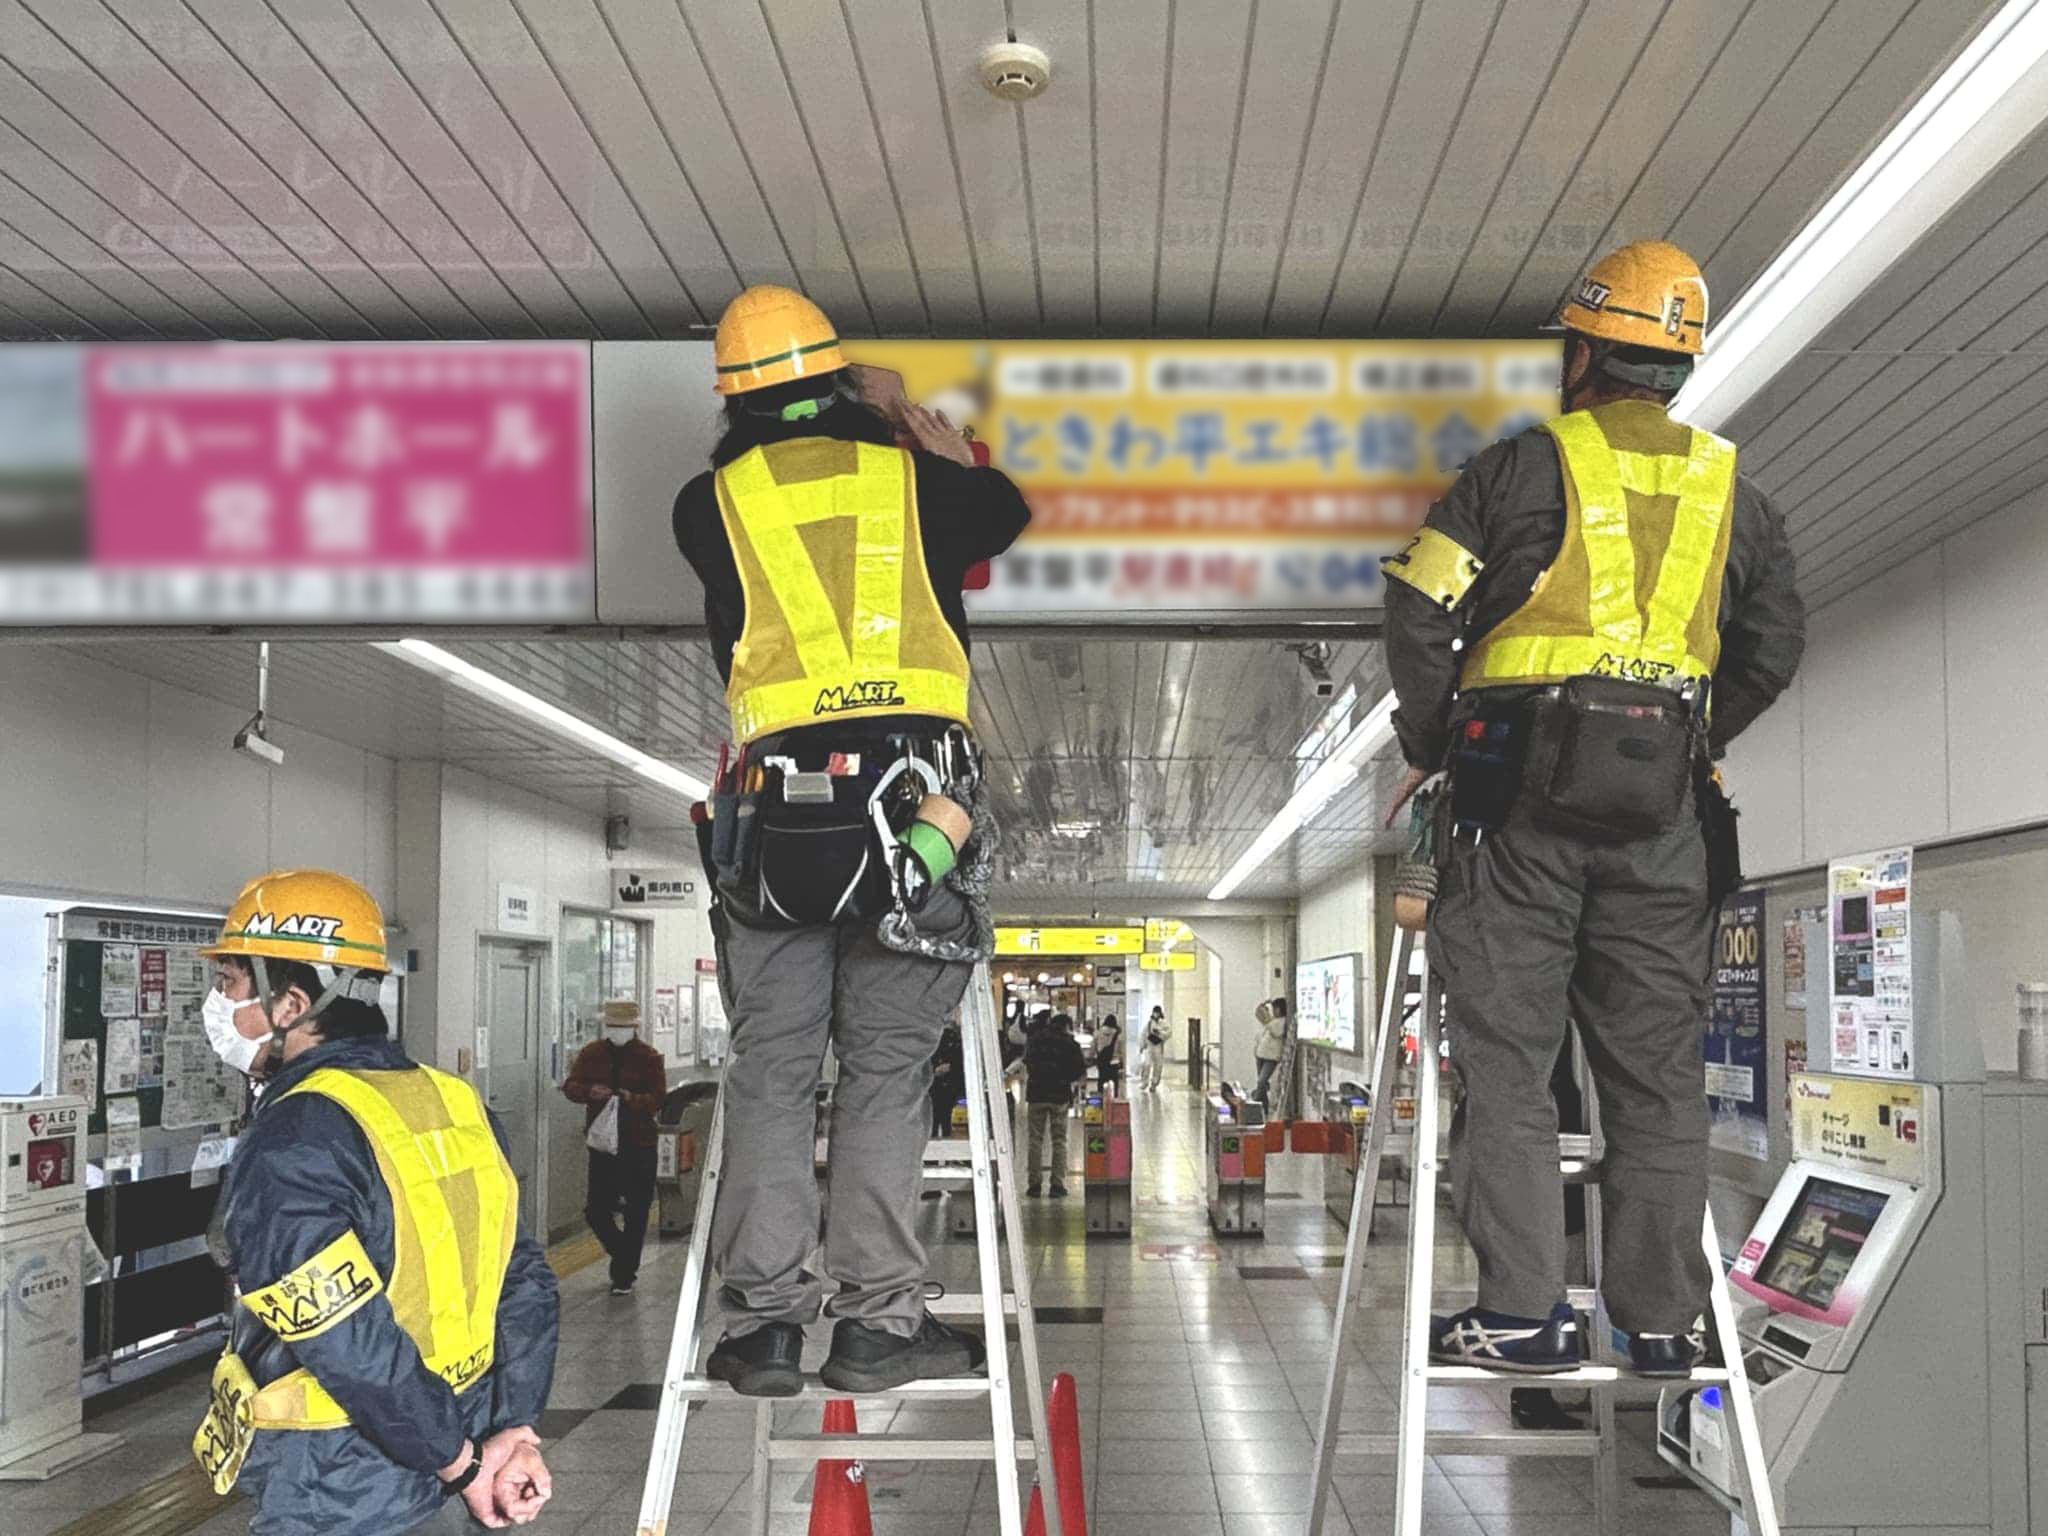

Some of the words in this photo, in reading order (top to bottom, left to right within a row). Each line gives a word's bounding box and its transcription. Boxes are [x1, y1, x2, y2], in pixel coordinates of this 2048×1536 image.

[116, 403, 551, 470] ハートホール
[814, 681, 905, 715] MART
[242, 911, 345, 942] MART
[48, 1109, 77, 1123] AED
